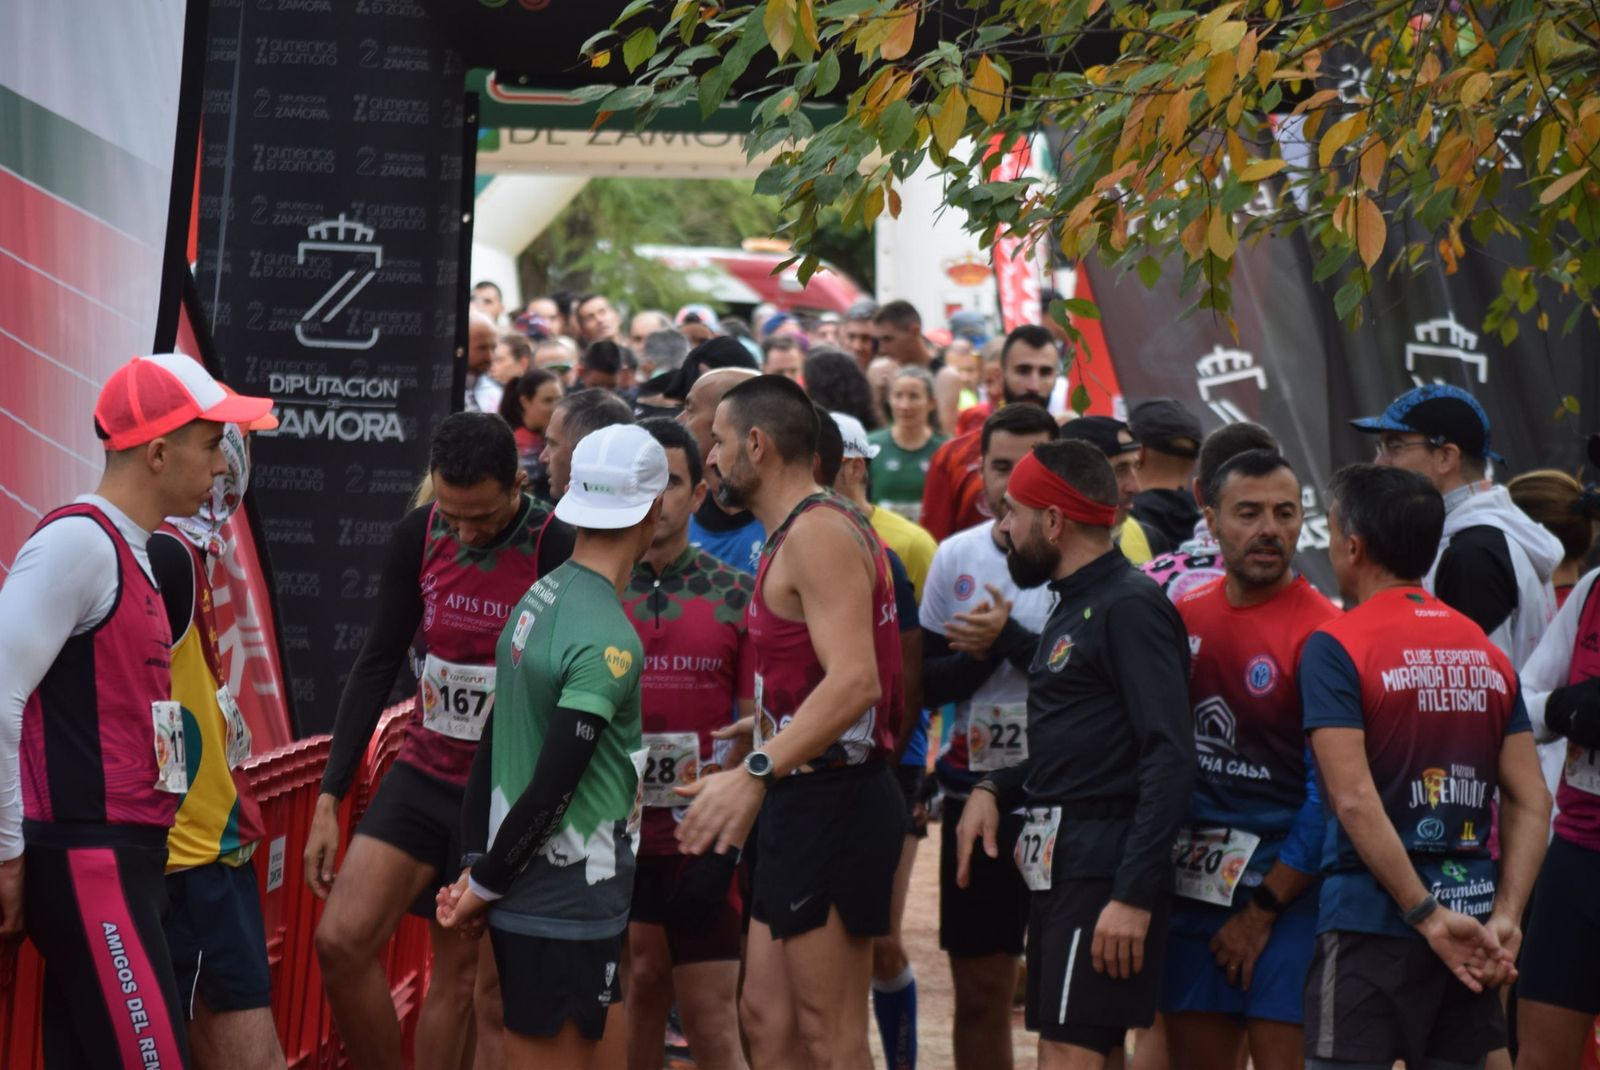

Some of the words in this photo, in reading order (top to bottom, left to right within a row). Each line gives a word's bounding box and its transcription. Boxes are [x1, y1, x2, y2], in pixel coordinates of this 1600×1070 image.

[445, 592, 479, 613] APIS
[483, 600, 515, 619] DU
[643, 655, 669, 671] PIS
[1403, 649, 1434, 665] CLUBE
[1381, 665, 1444, 692] MIRANDA
[1447, 666, 1467, 689] DO
[1469, 665, 1507, 695] DOURO
[439, 685, 488, 716] 167
[1418, 689, 1487, 712] ATLETISMO
[643, 757, 676, 784] 28
[1226, 760, 1271, 780] CASA
[101, 921, 138, 994] AMIGOS
[125, 997, 151, 1034] DEL
